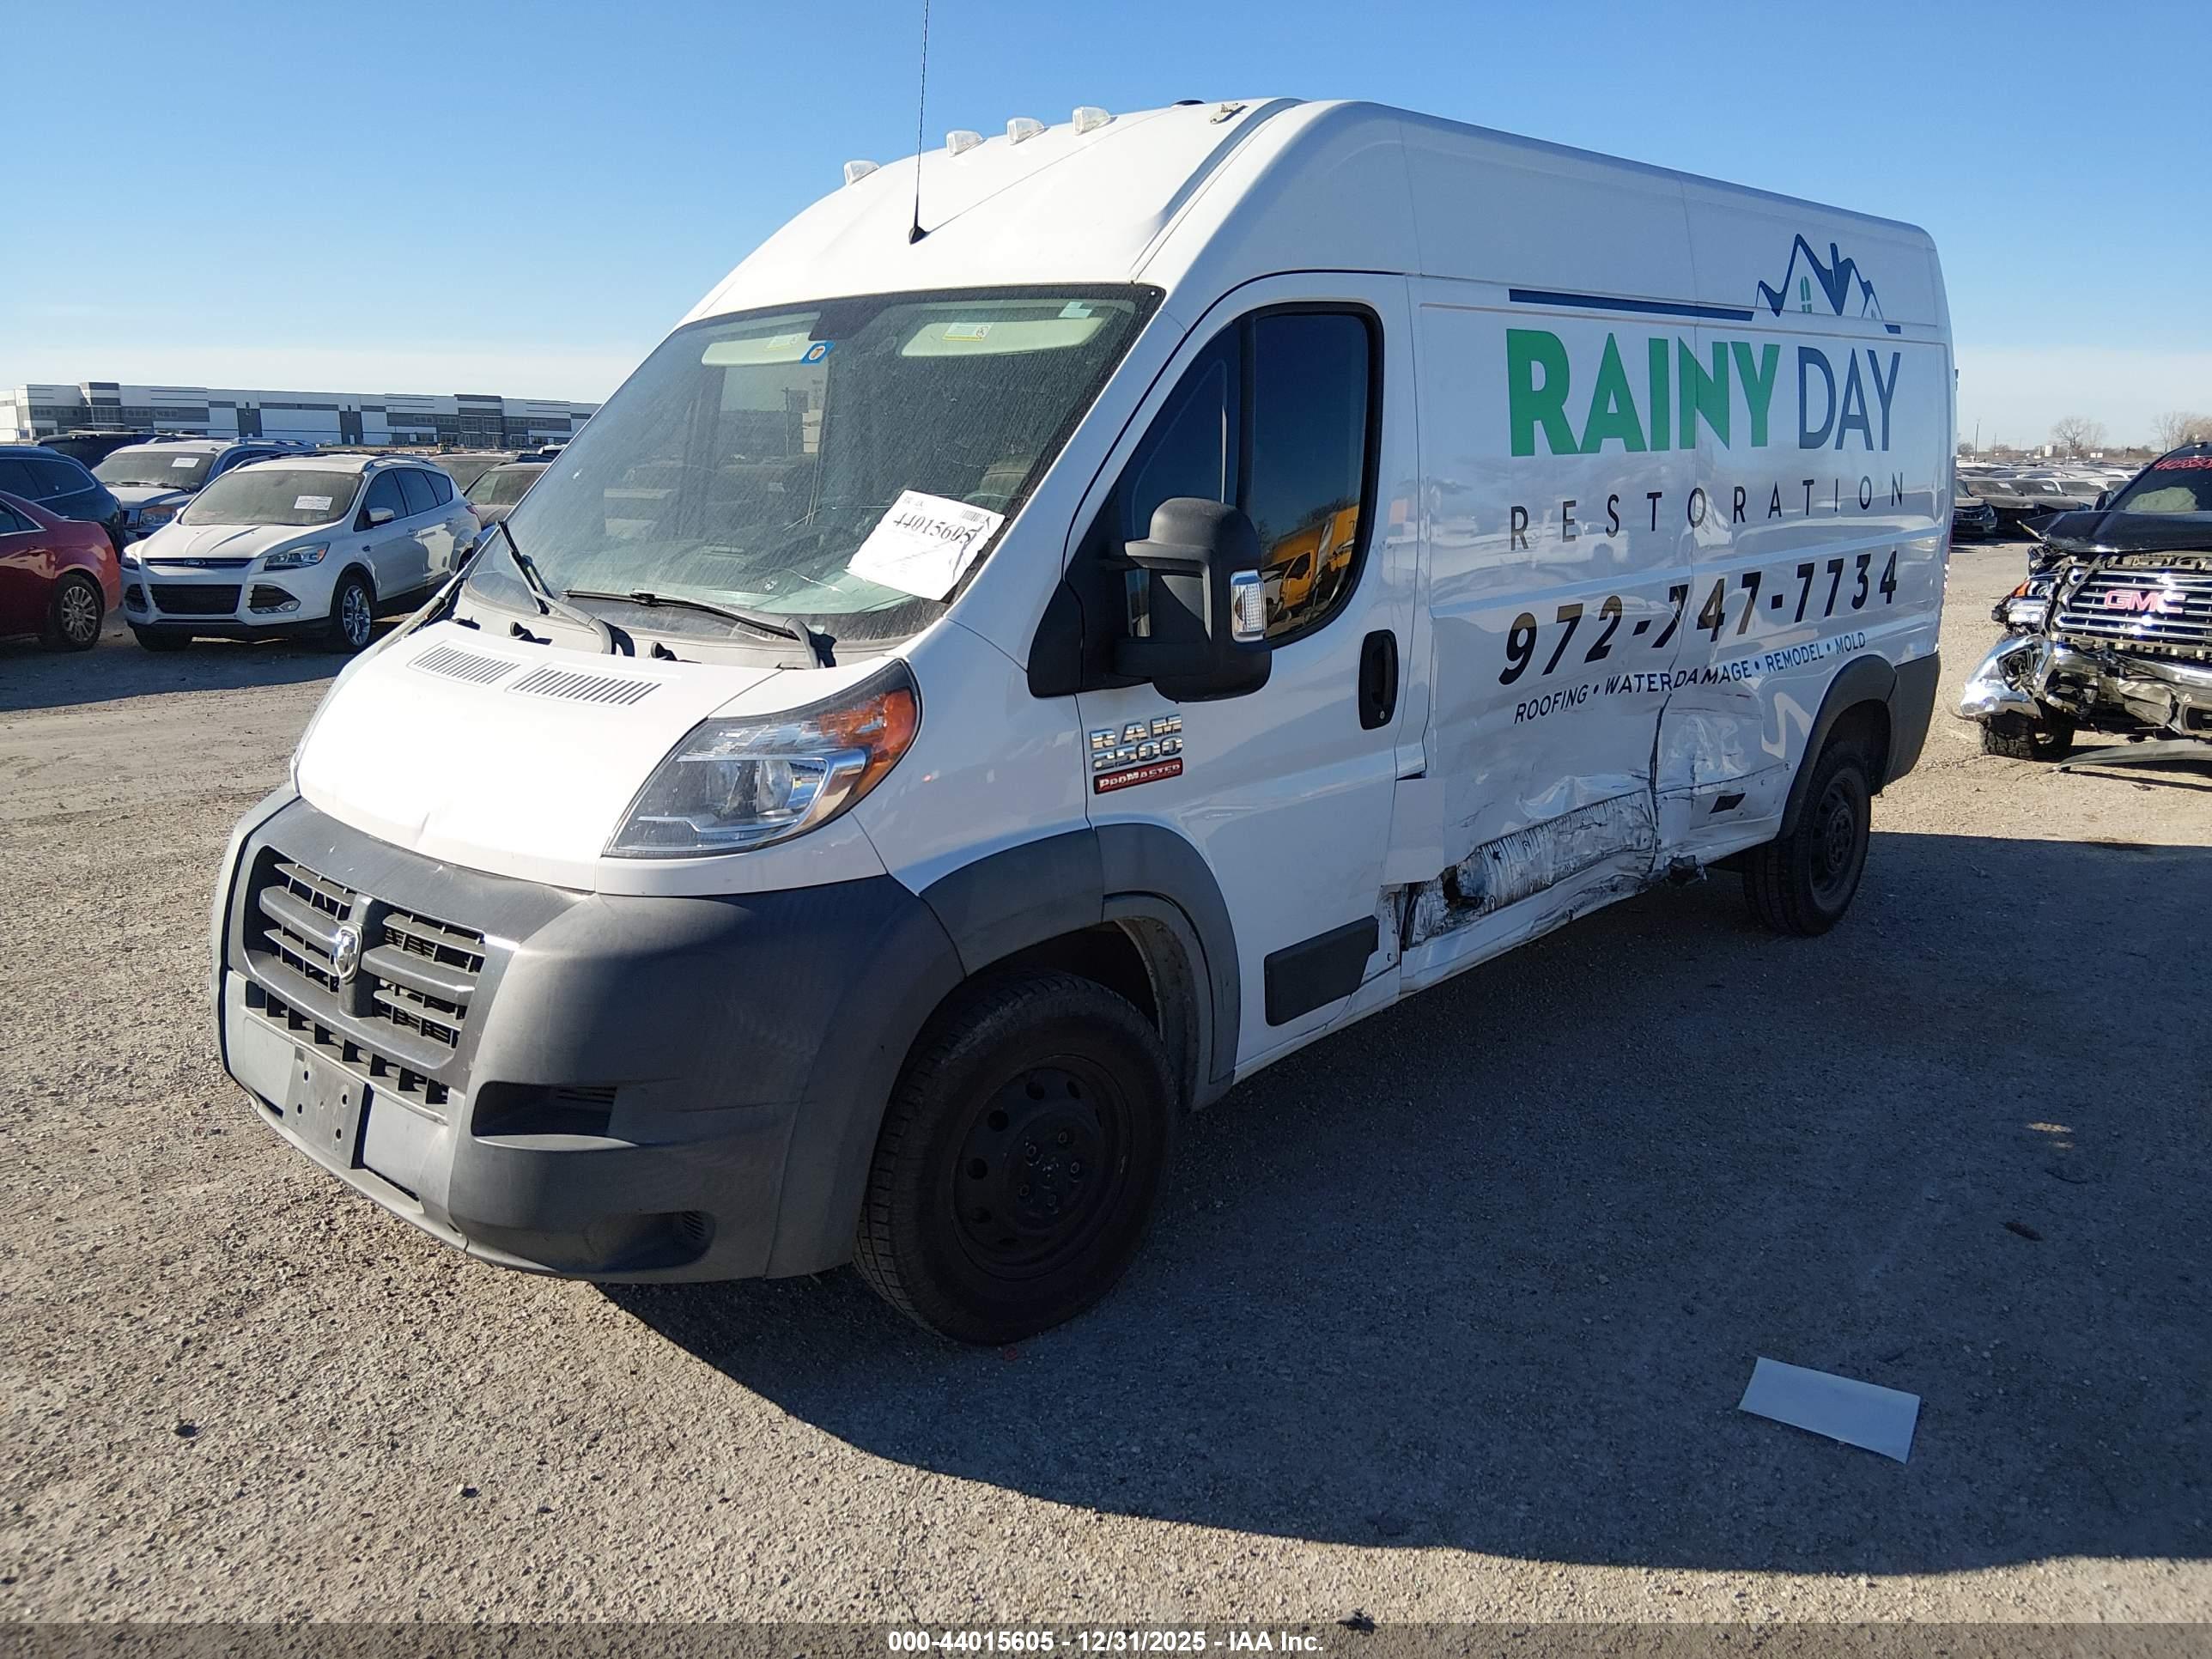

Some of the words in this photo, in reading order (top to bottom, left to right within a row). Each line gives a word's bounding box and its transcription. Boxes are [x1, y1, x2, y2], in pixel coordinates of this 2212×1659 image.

[1506, 327, 1781, 457] RAINY
[1797, 345, 1902, 452] DAY
[893, 512, 977, 545] 44015605
[1510, 471, 1904, 551] RESTORATION
[1498, 550, 1898, 685] 972-747-7734
[2104, 590, 2187, 614] GMC
[1514, 684, 1588, 725] ROOFING
[1765, 642, 1826, 674] REMODEL
[1834, 631, 1867, 654] MOLD
[1090, 714, 1182, 751] RAM
[1091, 735, 1183, 773] 2500
